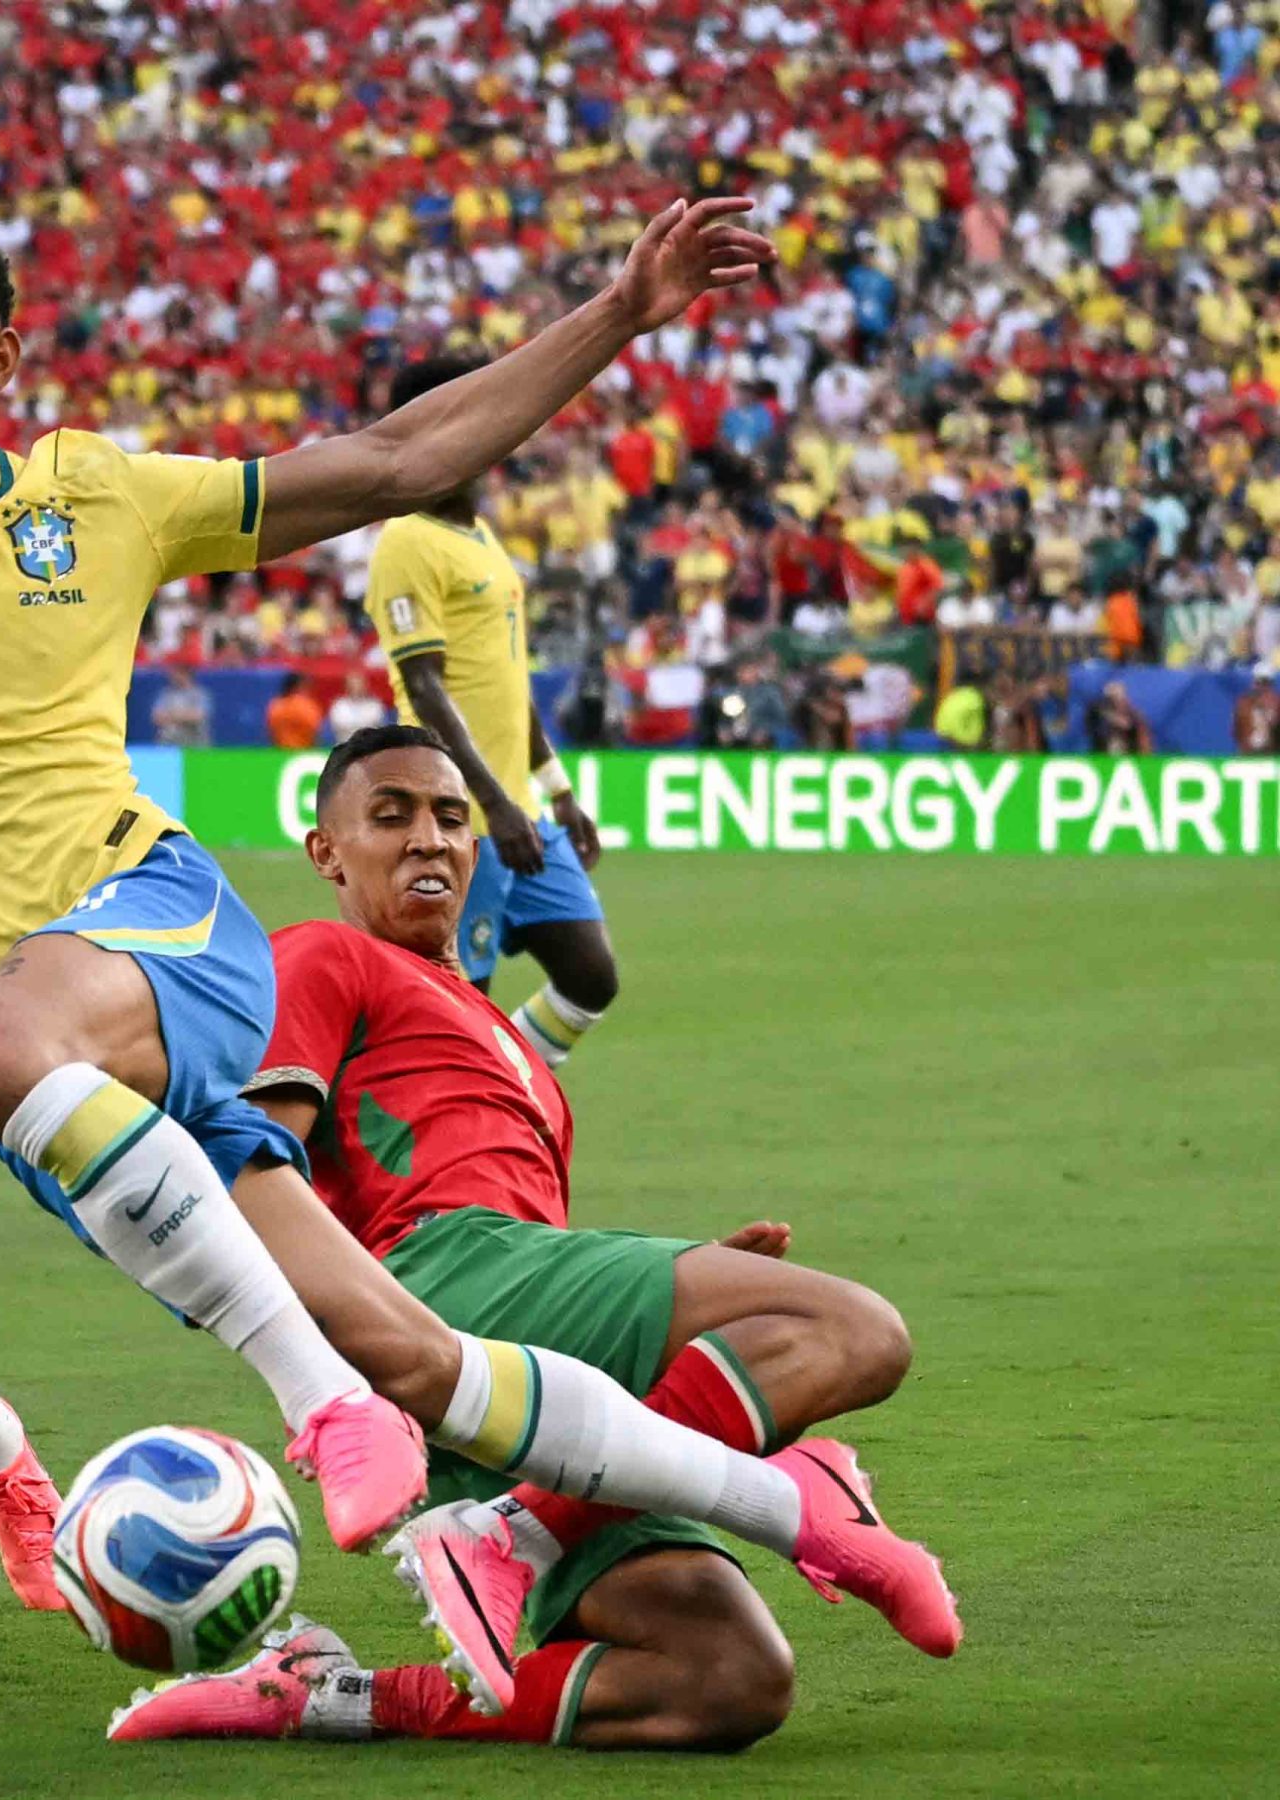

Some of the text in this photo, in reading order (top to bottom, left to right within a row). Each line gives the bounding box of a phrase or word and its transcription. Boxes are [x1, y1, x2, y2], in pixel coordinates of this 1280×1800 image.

[31, 539, 55, 549] CBF
[19, 588, 87, 606] BRASIL
[646, 755, 1020, 851] ENERGY
[1039, 758, 1280, 853] PART
[148, 1193, 204, 1246] BRASIL
